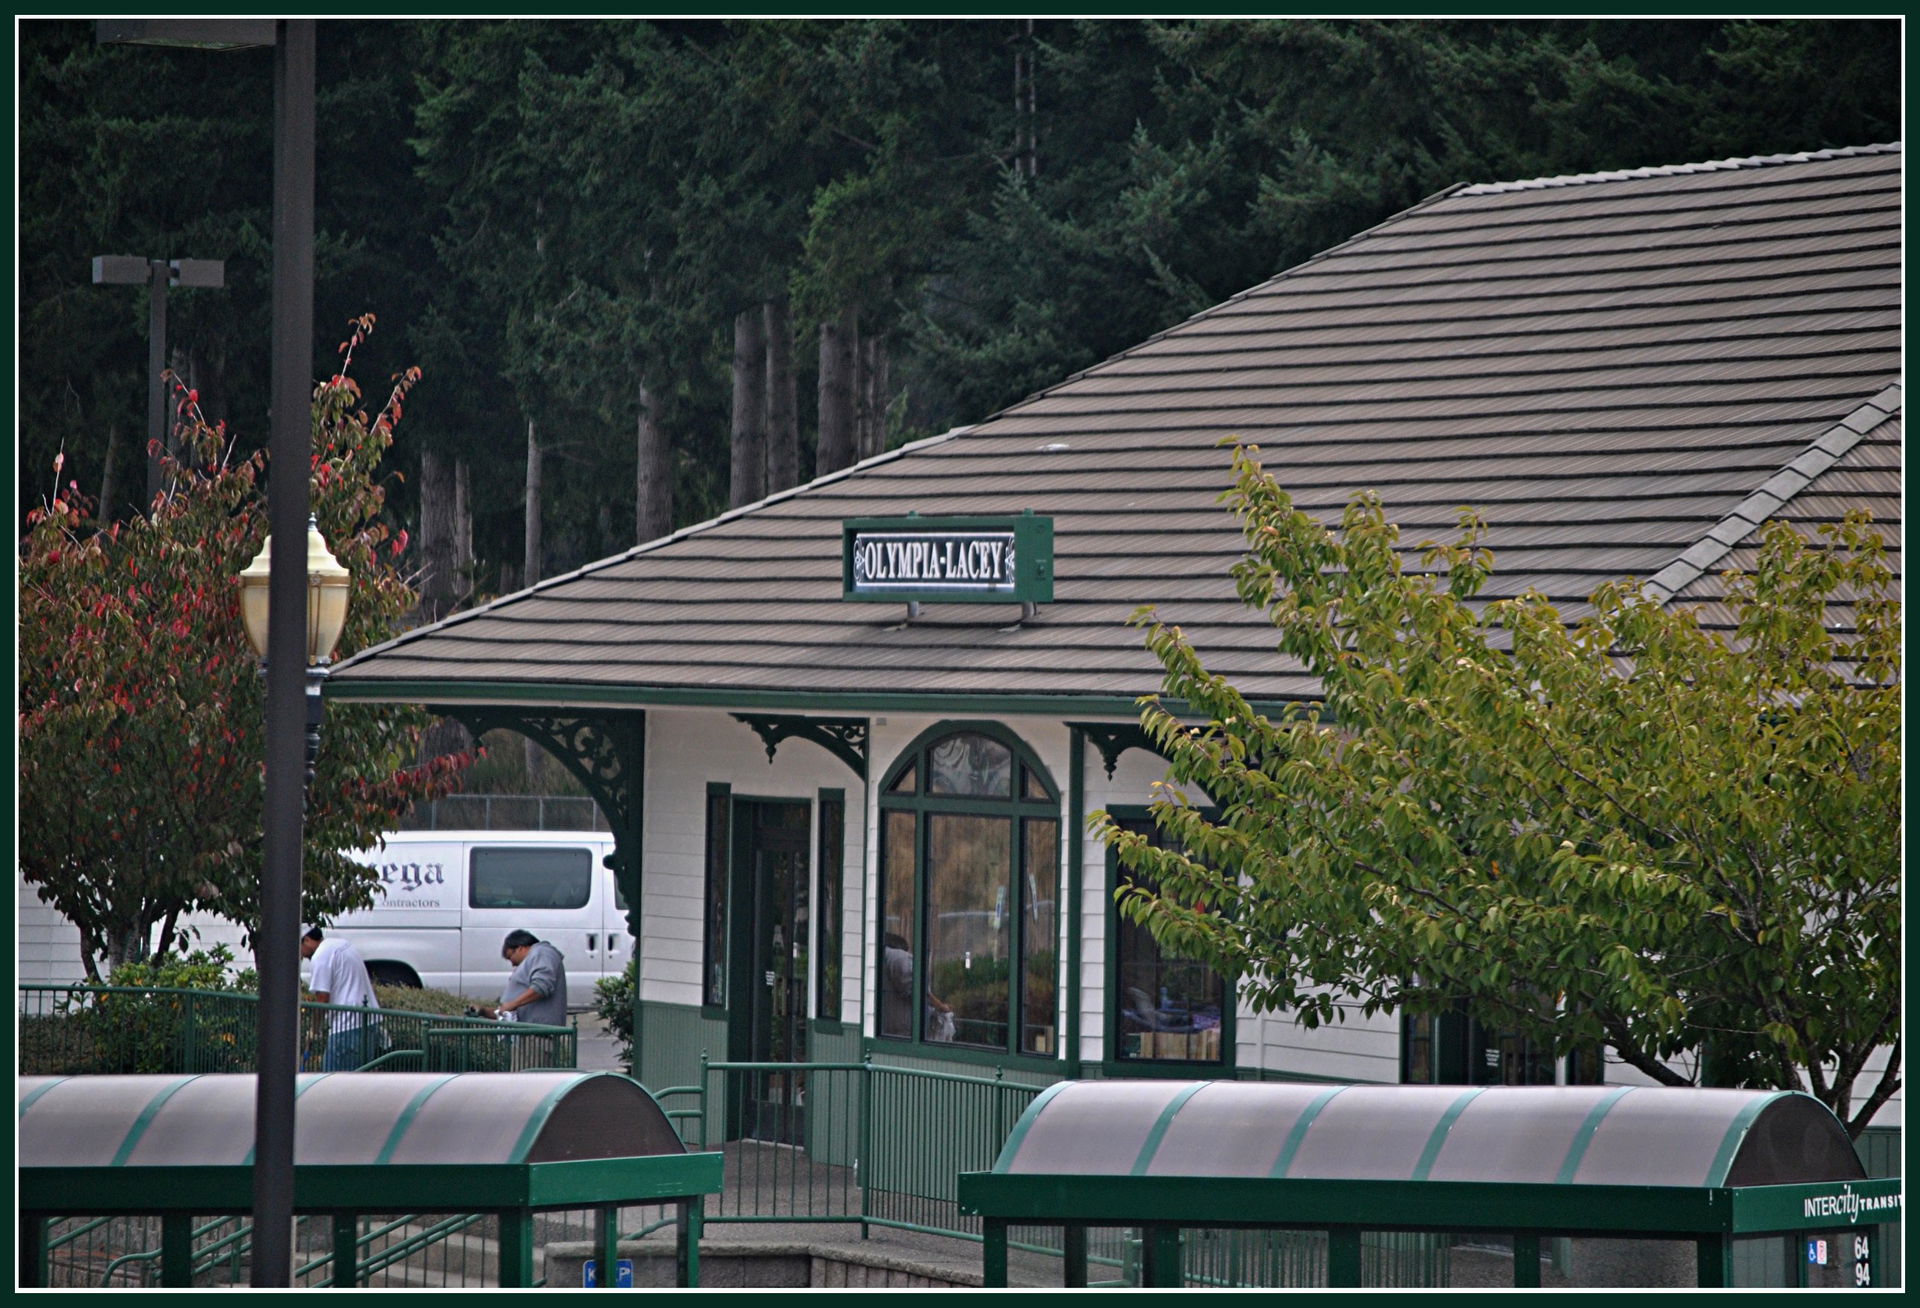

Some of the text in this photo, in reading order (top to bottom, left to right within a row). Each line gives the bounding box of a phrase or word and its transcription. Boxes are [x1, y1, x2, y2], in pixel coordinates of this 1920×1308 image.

[370, 862, 444, 891] ega
[378, 899, 440, 908] ontractors
[1854, 1236, 1869, 1259] 64
[1855, 1262, 1870, 1286] 94
